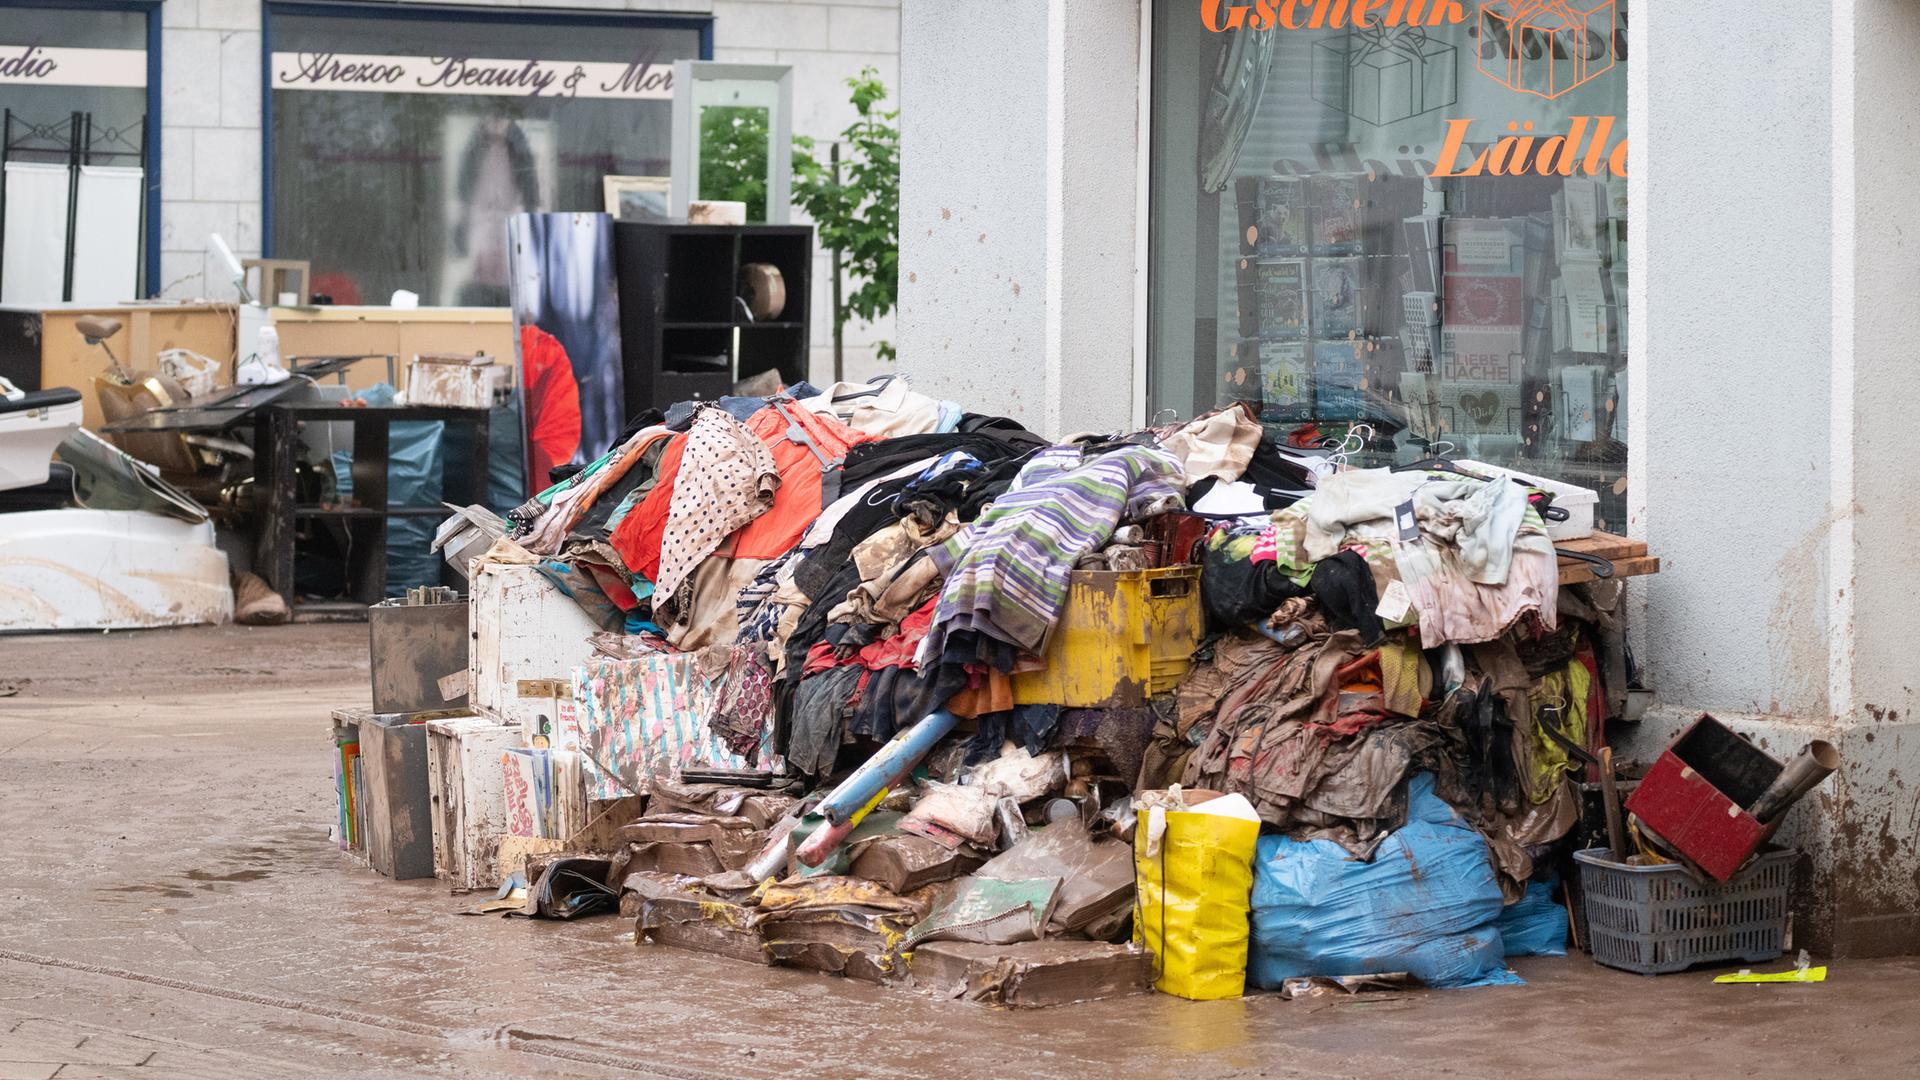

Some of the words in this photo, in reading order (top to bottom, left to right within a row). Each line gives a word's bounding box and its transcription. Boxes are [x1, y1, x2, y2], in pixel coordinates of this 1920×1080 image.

[280, 51, 405, 83] Arezoo
[417, 54, 555, 97] Beauty
[1456, 353, 1500, 366] LIEBE
[1444, 366, 1509, 380] LACHE
